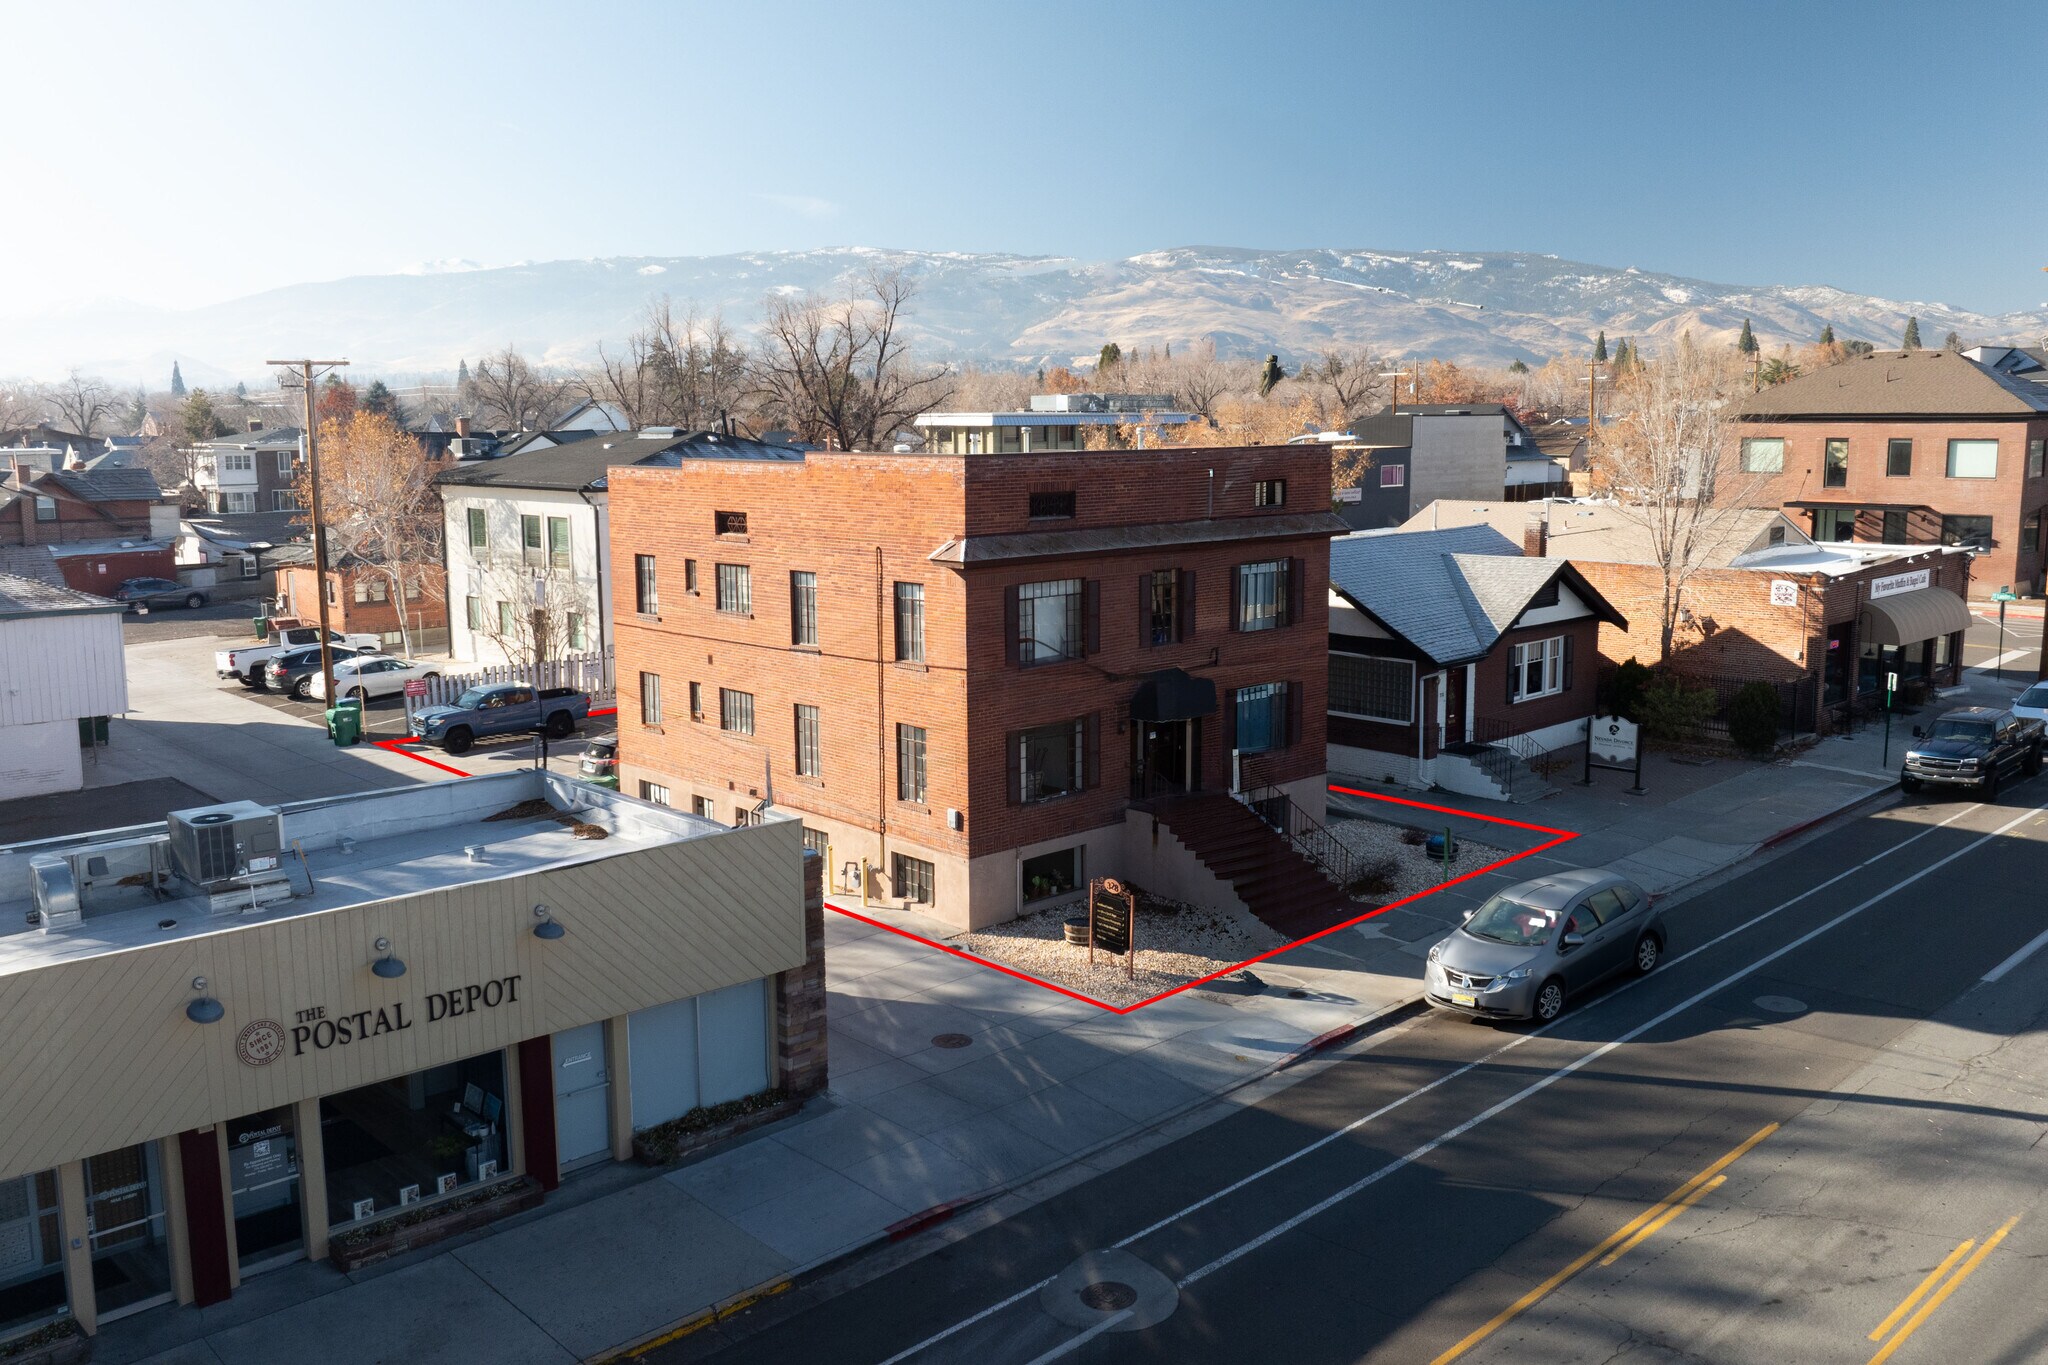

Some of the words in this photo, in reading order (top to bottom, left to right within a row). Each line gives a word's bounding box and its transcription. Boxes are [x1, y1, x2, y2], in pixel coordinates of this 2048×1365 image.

[1895, 577, 1906, 588] Muffin
[1909, 575, 1919, 588] Bagel
[1107, 882, 1119, 892] 328
[291, 1002, 412, 1056] POSTAL
[425, 975, 521, 1022] DEPOT
[295, 1005, 326, 1024] THE
[249, 1031, 272, 1048] SINCE
[565, 1051, 591, 1062] ENTRANCE
[249, 1130, 266, 1139] POSTAL
[266, 1124, 281, 1133] DEPOT
